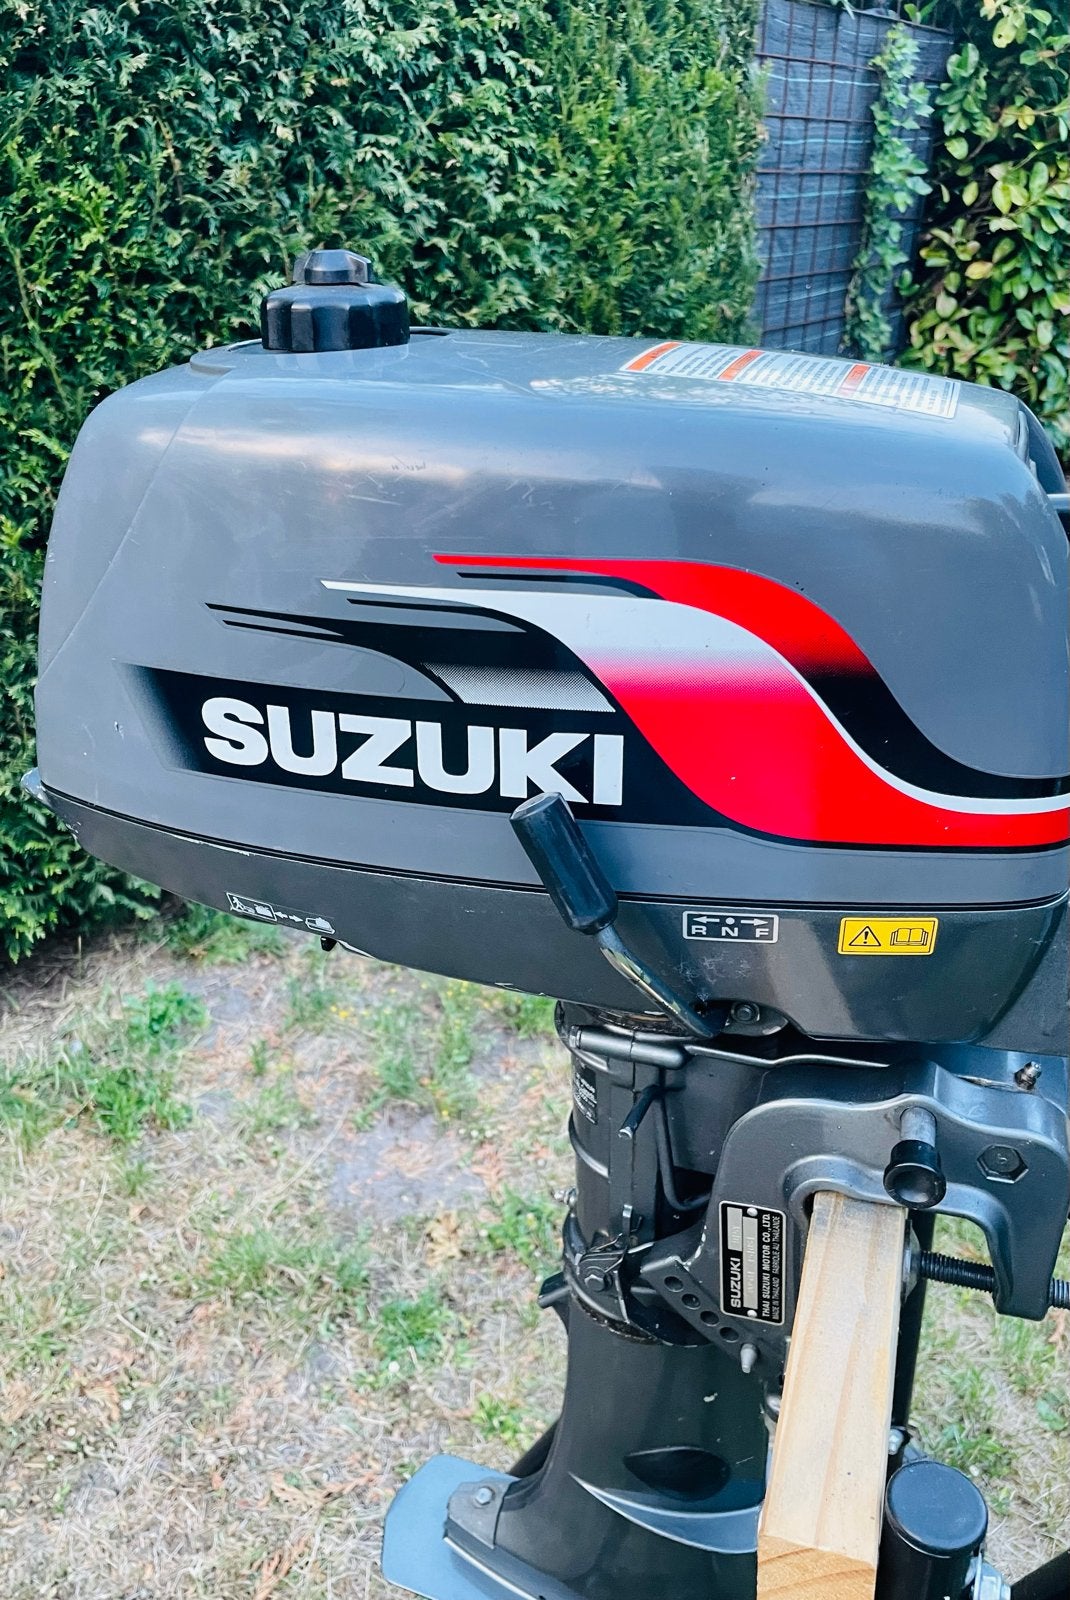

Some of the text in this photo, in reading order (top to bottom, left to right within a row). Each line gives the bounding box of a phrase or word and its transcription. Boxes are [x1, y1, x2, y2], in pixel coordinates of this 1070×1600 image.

[201, 697, 624, 806] SUZUKI
[691, 925, 770, 938] R N F
[762, 1245, 770, 1271] MOTOR
[730, 1257, 741, 1308] SUZUKI
[762, 1273, 770, 1299] SUZUKI
[772, 1277, 780, 1300] THAILAND
[762, 1301, 770, 1317] THAI
